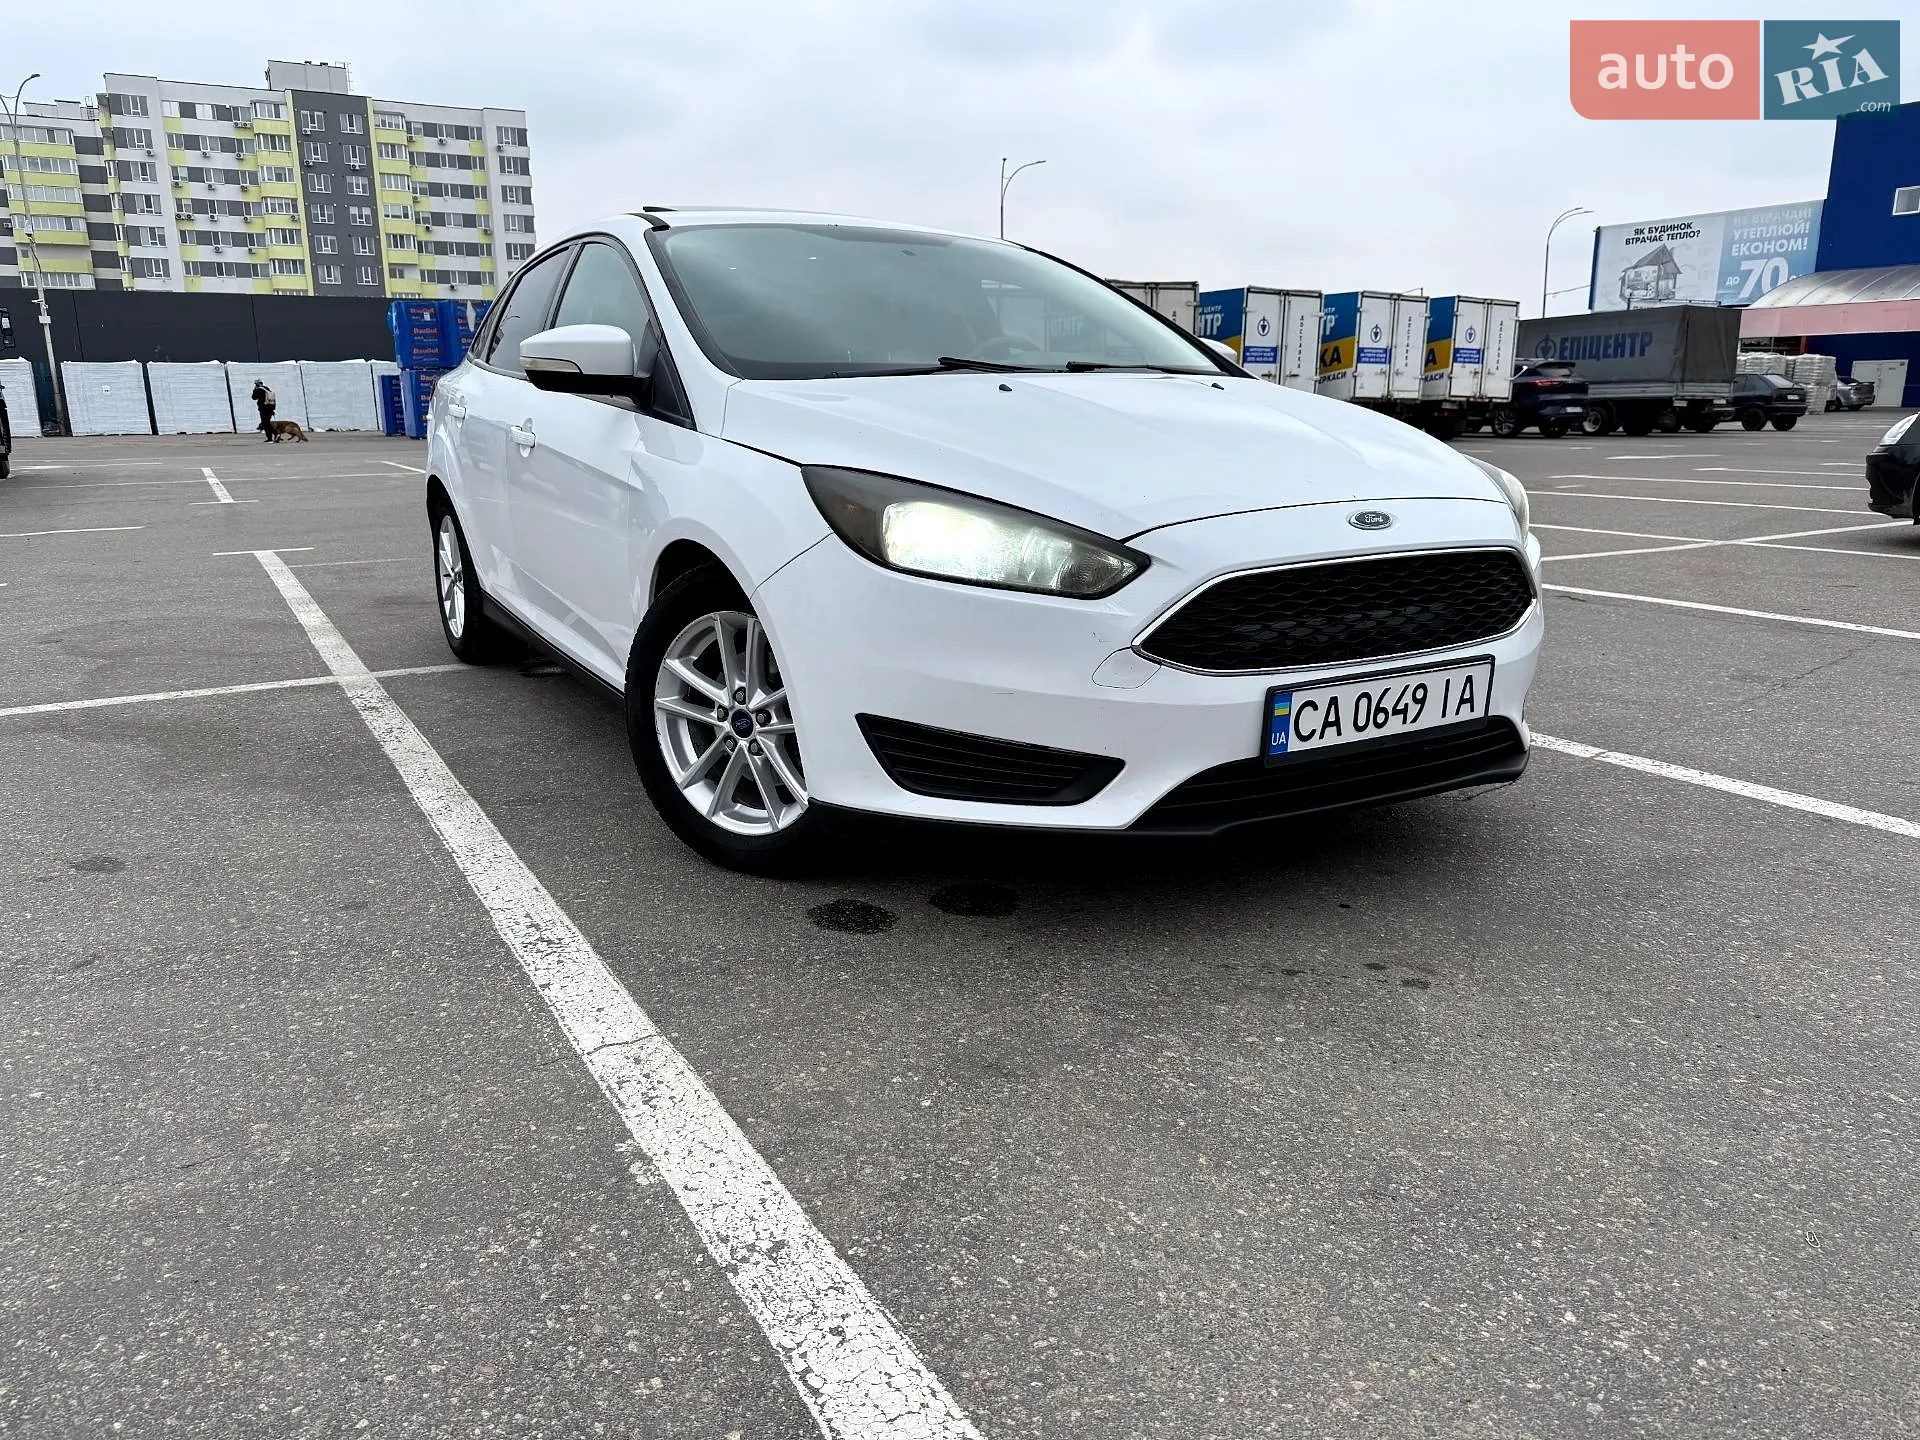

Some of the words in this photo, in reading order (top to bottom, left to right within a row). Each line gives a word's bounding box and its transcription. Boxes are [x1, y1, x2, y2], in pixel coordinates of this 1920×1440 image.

[1625, 233, 1665, 246] ВТРАЧАЄ
[1666, 229, 1701, 242] ТЕПЛО?
[1633, 227, 1646, 236] ЯК
[1647, 221, 1693, 235] БУДИНОК
[1733, 220, 1810, 241] УТЕПЛЮЙ!
[1731, 236, 1809, 257] ЕКОНОМ!
[1737, 257, 1789, 302] 70
[1558, 331, 1653, 362] ЕПІЦЕНТР
[1364, 513, 1384, 523] Ford
[1293, 695, 1342, 742] CA
[1352, 682, 1429, 733] 0649
[1441, 674, 1476, 719] IA
[1271, 731, 1287, 746] UA
